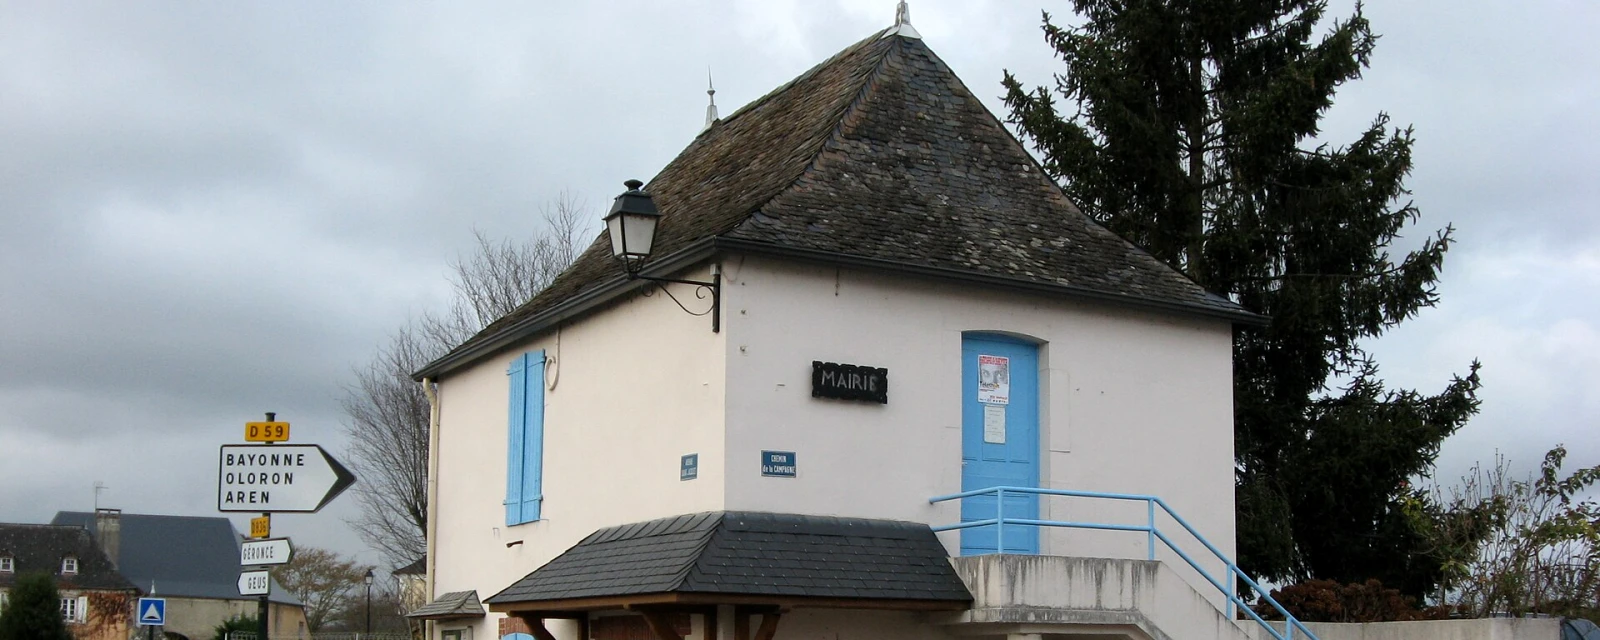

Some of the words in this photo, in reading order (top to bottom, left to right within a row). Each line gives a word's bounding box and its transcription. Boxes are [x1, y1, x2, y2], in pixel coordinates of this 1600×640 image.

[249, 425, 259, 438] D
[264, 425, 284, 438] 59
[226, 453, 305, 466] BAYONNE
[770, 454, 787, 463] CHEMIN
[773, 465, 796, 474] CAMPAGNE
[226, 472, 294, 485] OLORON
[225, 490, 270, 504] AREN
[243, 544, 274, 561] GÉRONCE
[247, 576, 267, 590] GEUS
